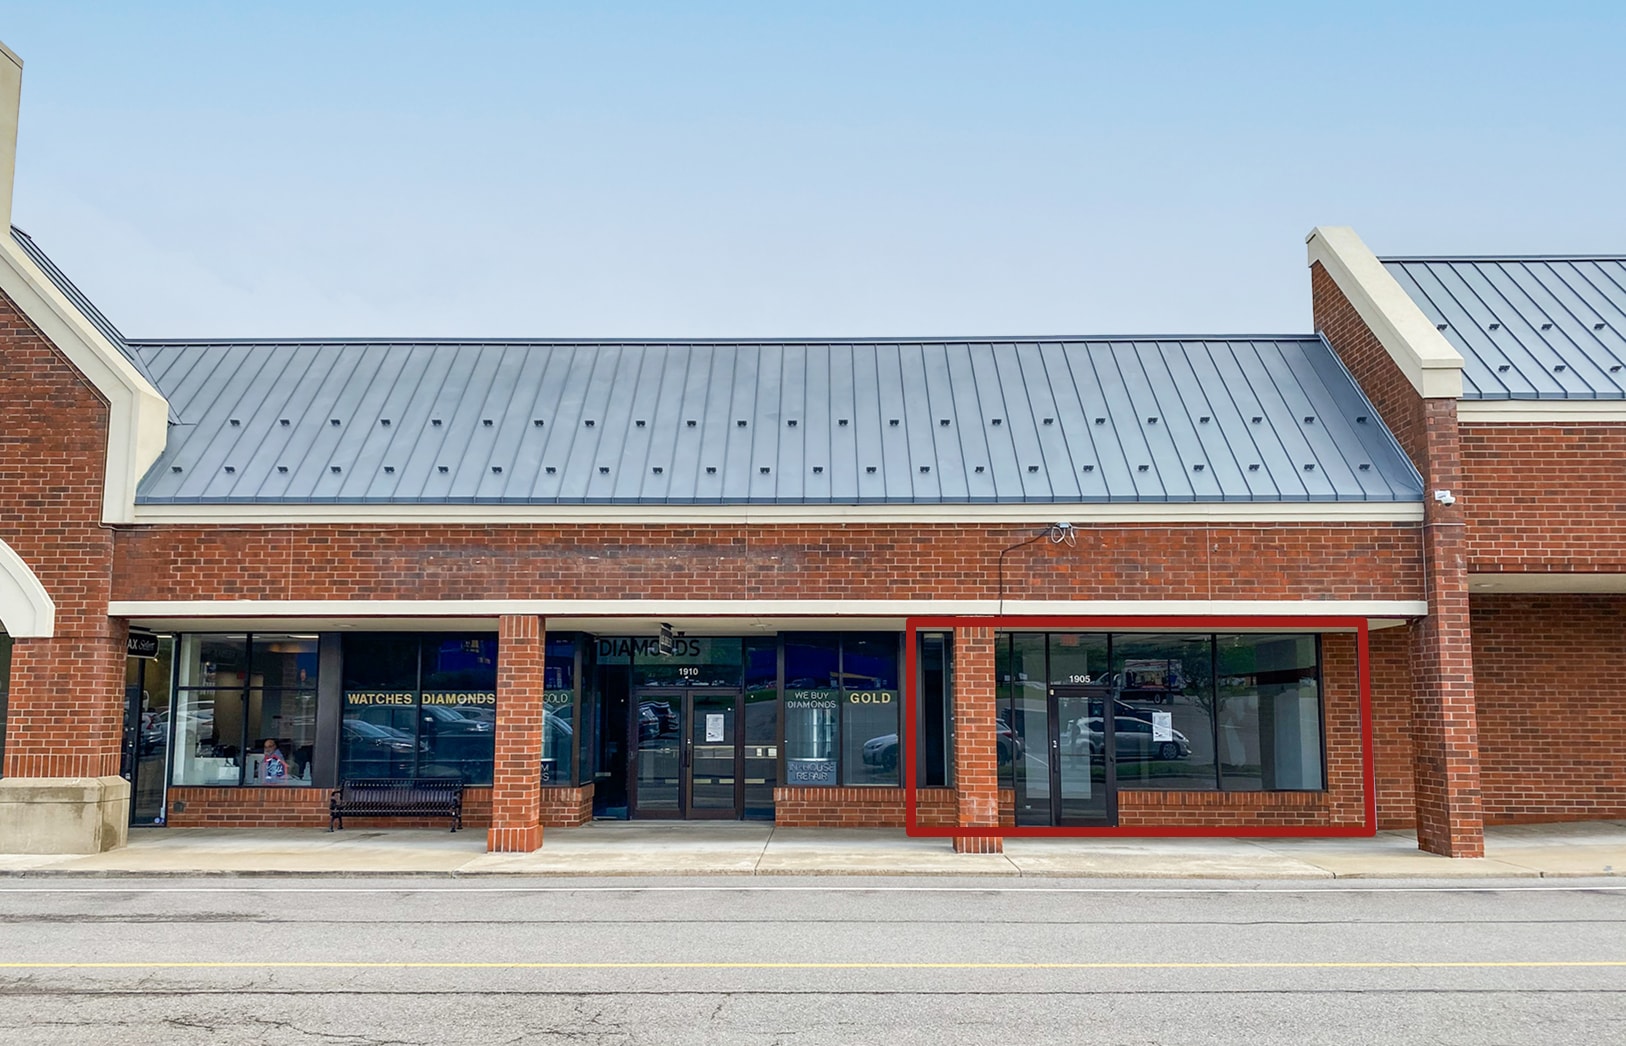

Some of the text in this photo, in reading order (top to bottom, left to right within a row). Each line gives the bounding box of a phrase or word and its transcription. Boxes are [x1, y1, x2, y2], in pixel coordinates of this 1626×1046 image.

[600, 639, 701, 657] DIAMODS
[678, 667, 699, 676] 1910
[1069, 675, 1091, 684] 1905
[348, 693, 496, 705] WATCHES DIAMONDS
[794, 691, 829, 700] WE BUY
[850, 692, 891, 704] GOLD
[787, 700, 837, 709] DIAMONDS
